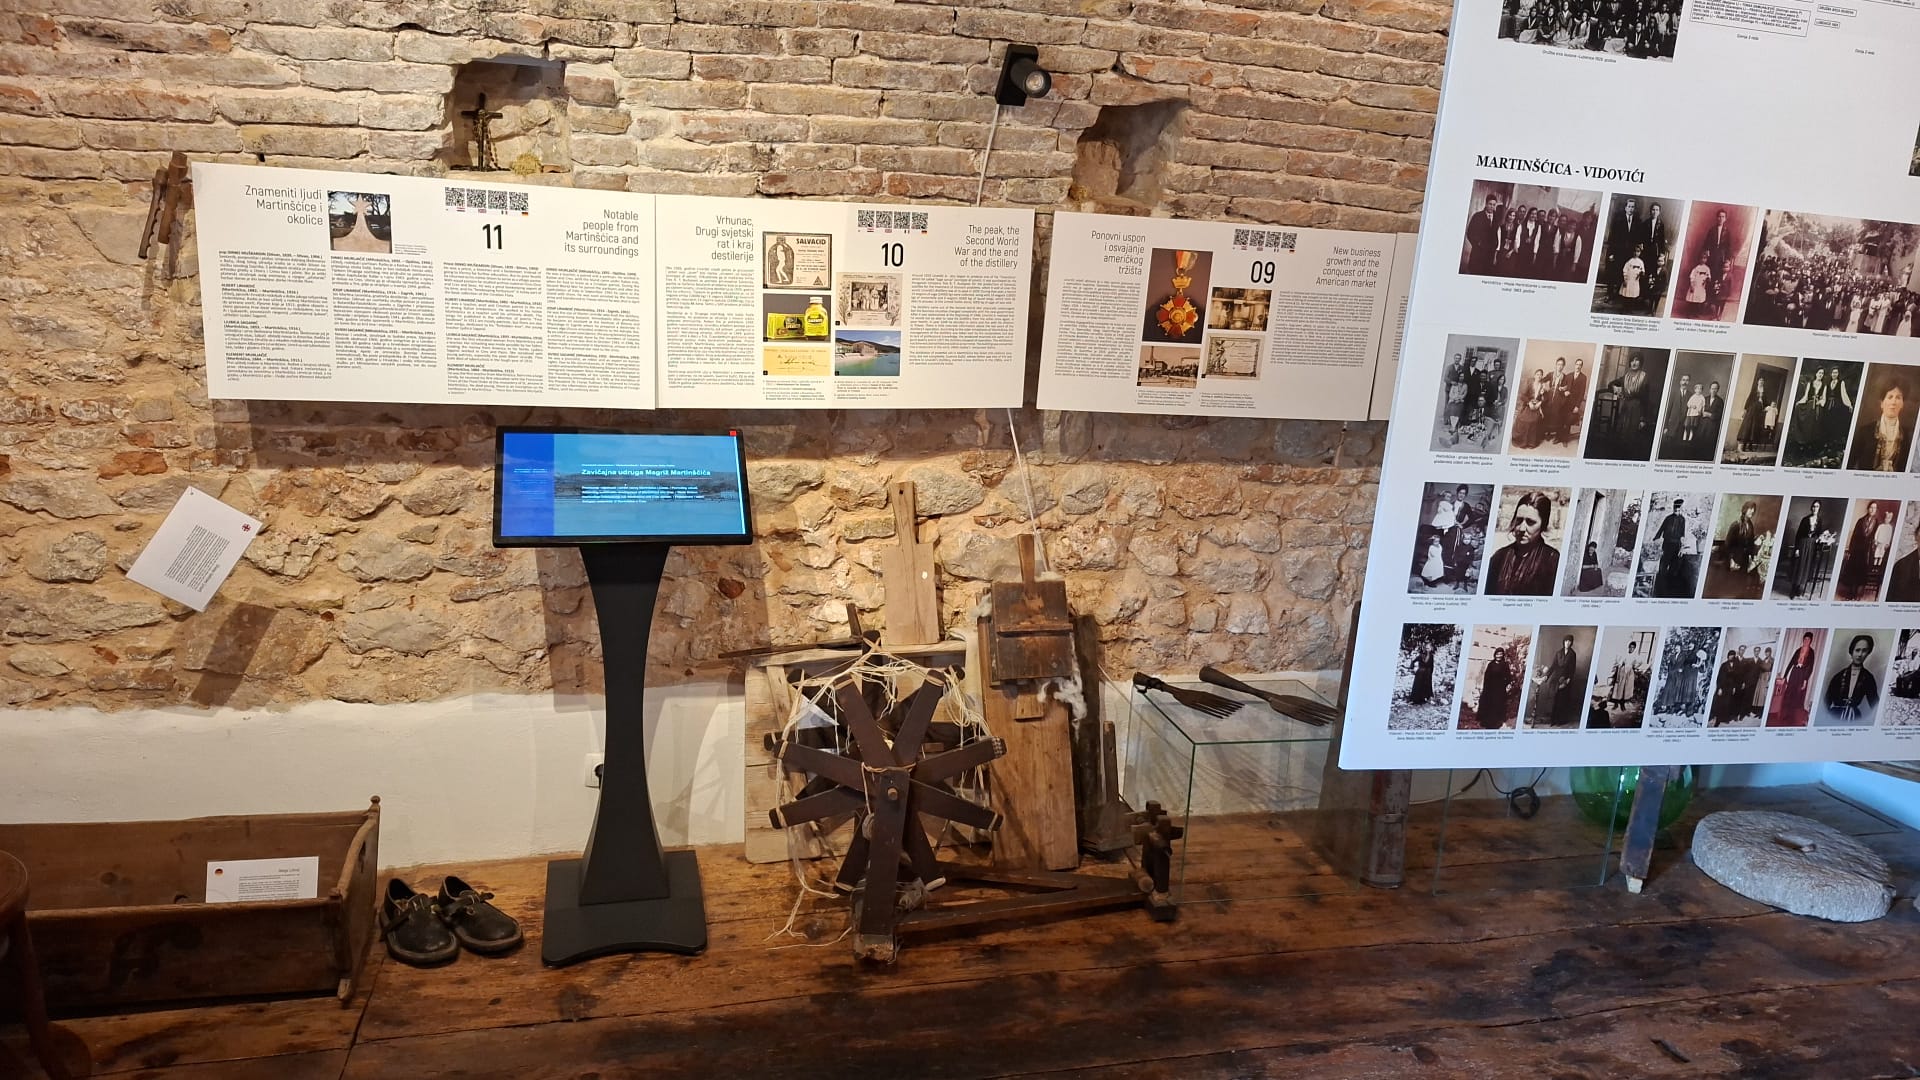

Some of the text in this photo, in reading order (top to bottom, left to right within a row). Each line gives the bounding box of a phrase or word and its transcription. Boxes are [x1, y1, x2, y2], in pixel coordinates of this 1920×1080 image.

[1476, 154, 1572, 176] MARTINŠĆICA
[1584, 165, 1646, 184] VIDOVIĆI
[245, 185, 322, 200] Znameniti ljudi
[256, 199, 317, 212] Martinšćice
[287, 214, 323, 225] okolice
[604, 209, 639, 220] Notable
[583, 220, 639, 232] people from
[716, 216, 754, 227] Vrhunac,
[696, 226, 754, 239] Drugi svjetski
[968, 225, 1020, 236] The peak, the
[482, 224, 503, 250] 11
[566, 231, 639, 244] Martinšćica and
[966, 236, 1019, 246] Second World
[1091, 230, 1146, 243] Ponovni uspon
[564, 242, 639, 258] its surroundings
[718, 240, 730, 248] rat
[738, 240, 754, 251] kraj
[1109, 244, 1144, 254] osvajanje
[712, 250, 754, 262] destilerije
[881, 243, 904, 267] 10
[954, 246, 1019, 257] War and the end
[1333, 246, 1381, 257] New business
[960, 258, 1018, 269] of the distillery
[1104, 255, 1143, 266] američkog
[1326, 257, 1380, 268] growth and the
[1119, 266, 1142, 275] tržišta
[1251, 261, 1276, 283] 09
[1322, 268, 1378, 278] conquest of the
[1316, 277, 1376, 288] American market
